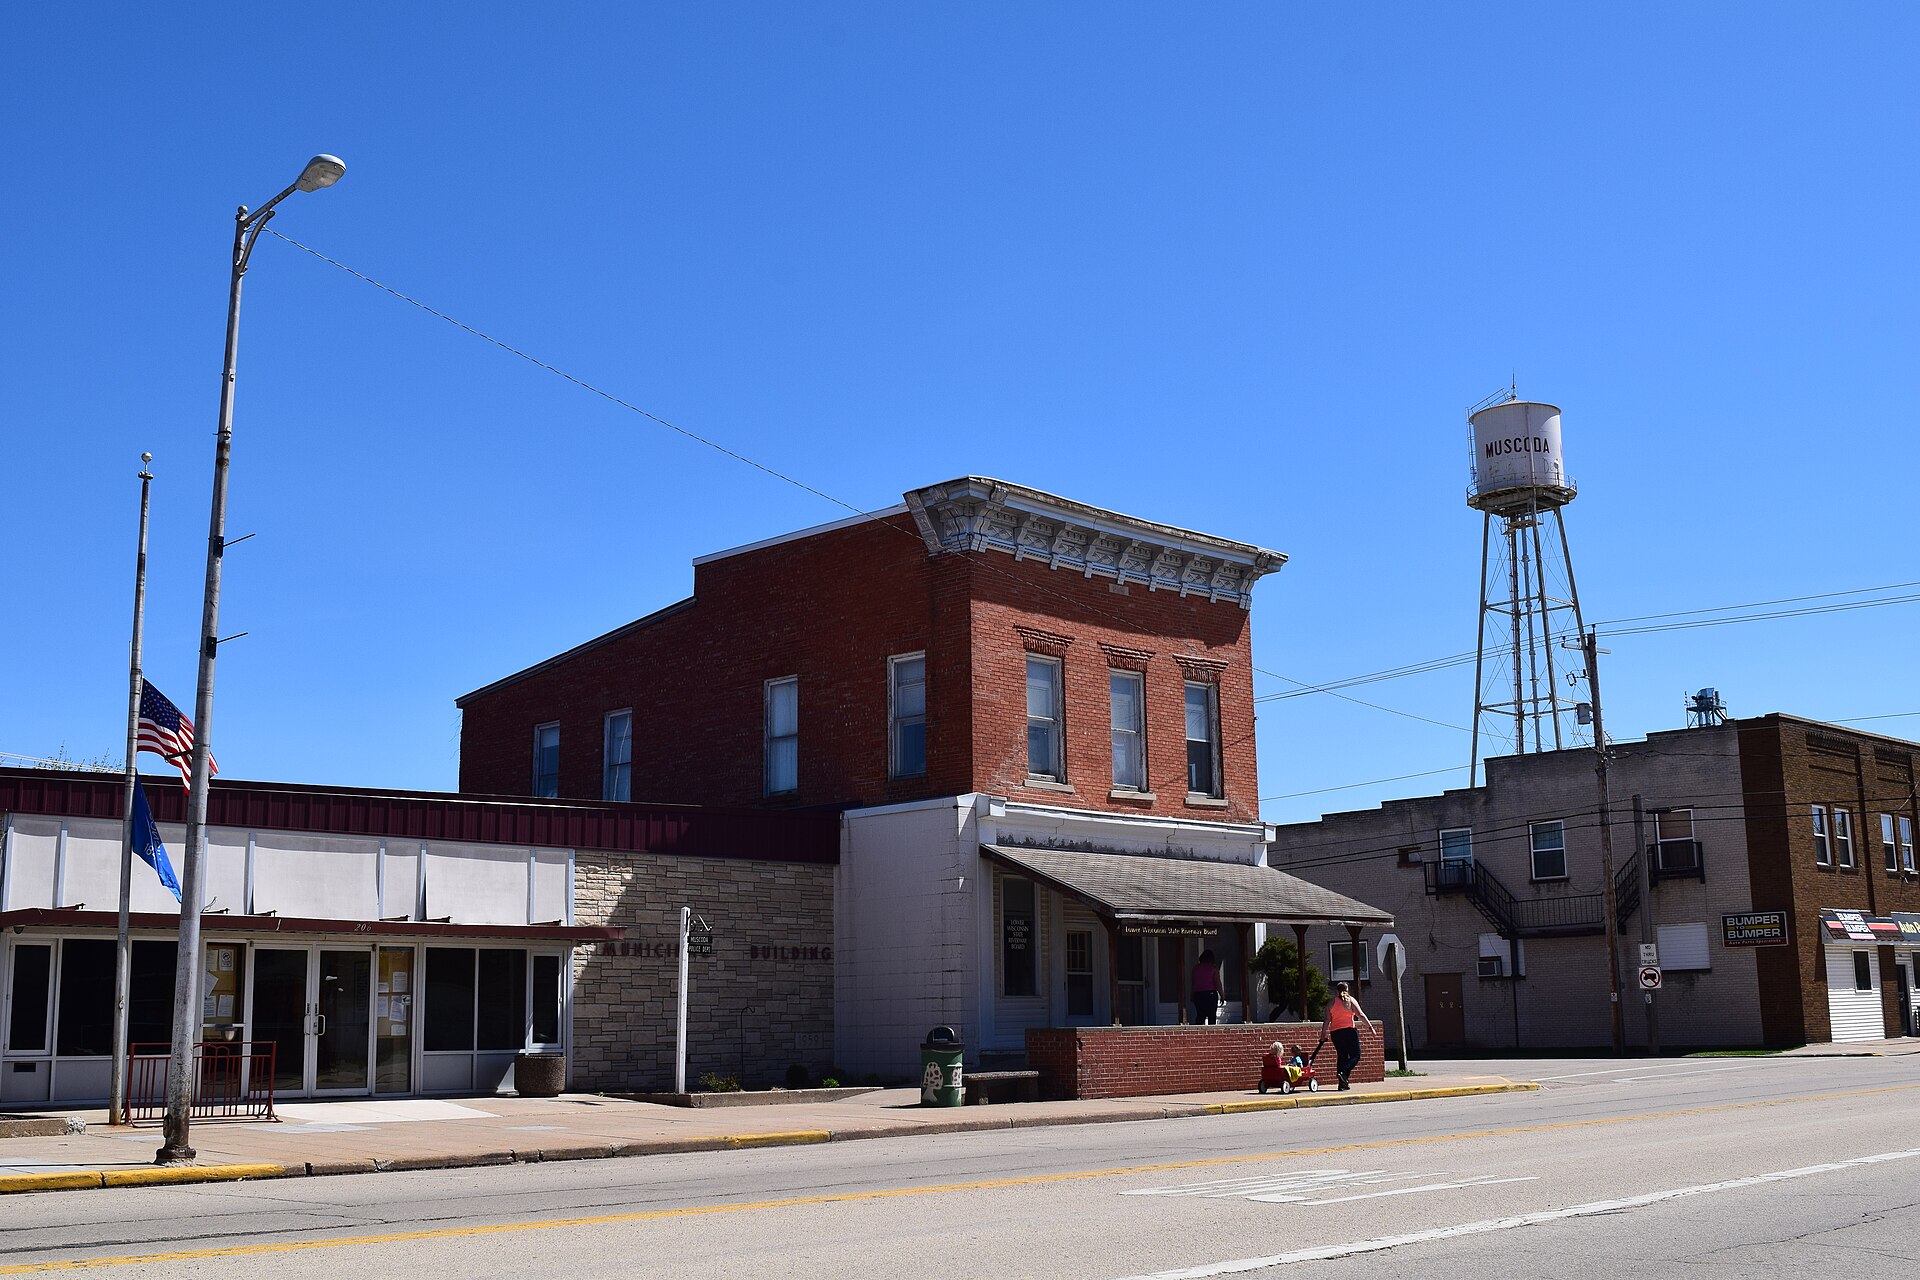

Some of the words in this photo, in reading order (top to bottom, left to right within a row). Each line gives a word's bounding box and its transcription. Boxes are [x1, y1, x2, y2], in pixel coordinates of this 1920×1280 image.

[1485, 436, 1550, 459] MUSCODA
[1726, 915, 1780, 926] BUMPER
[1897, 920, 1917, 933] Auto
[354, 922, 372, 932] 206
[1728, 928, 1781, 939] BUMPER
[751, 946, 832, 961] BUILDING
